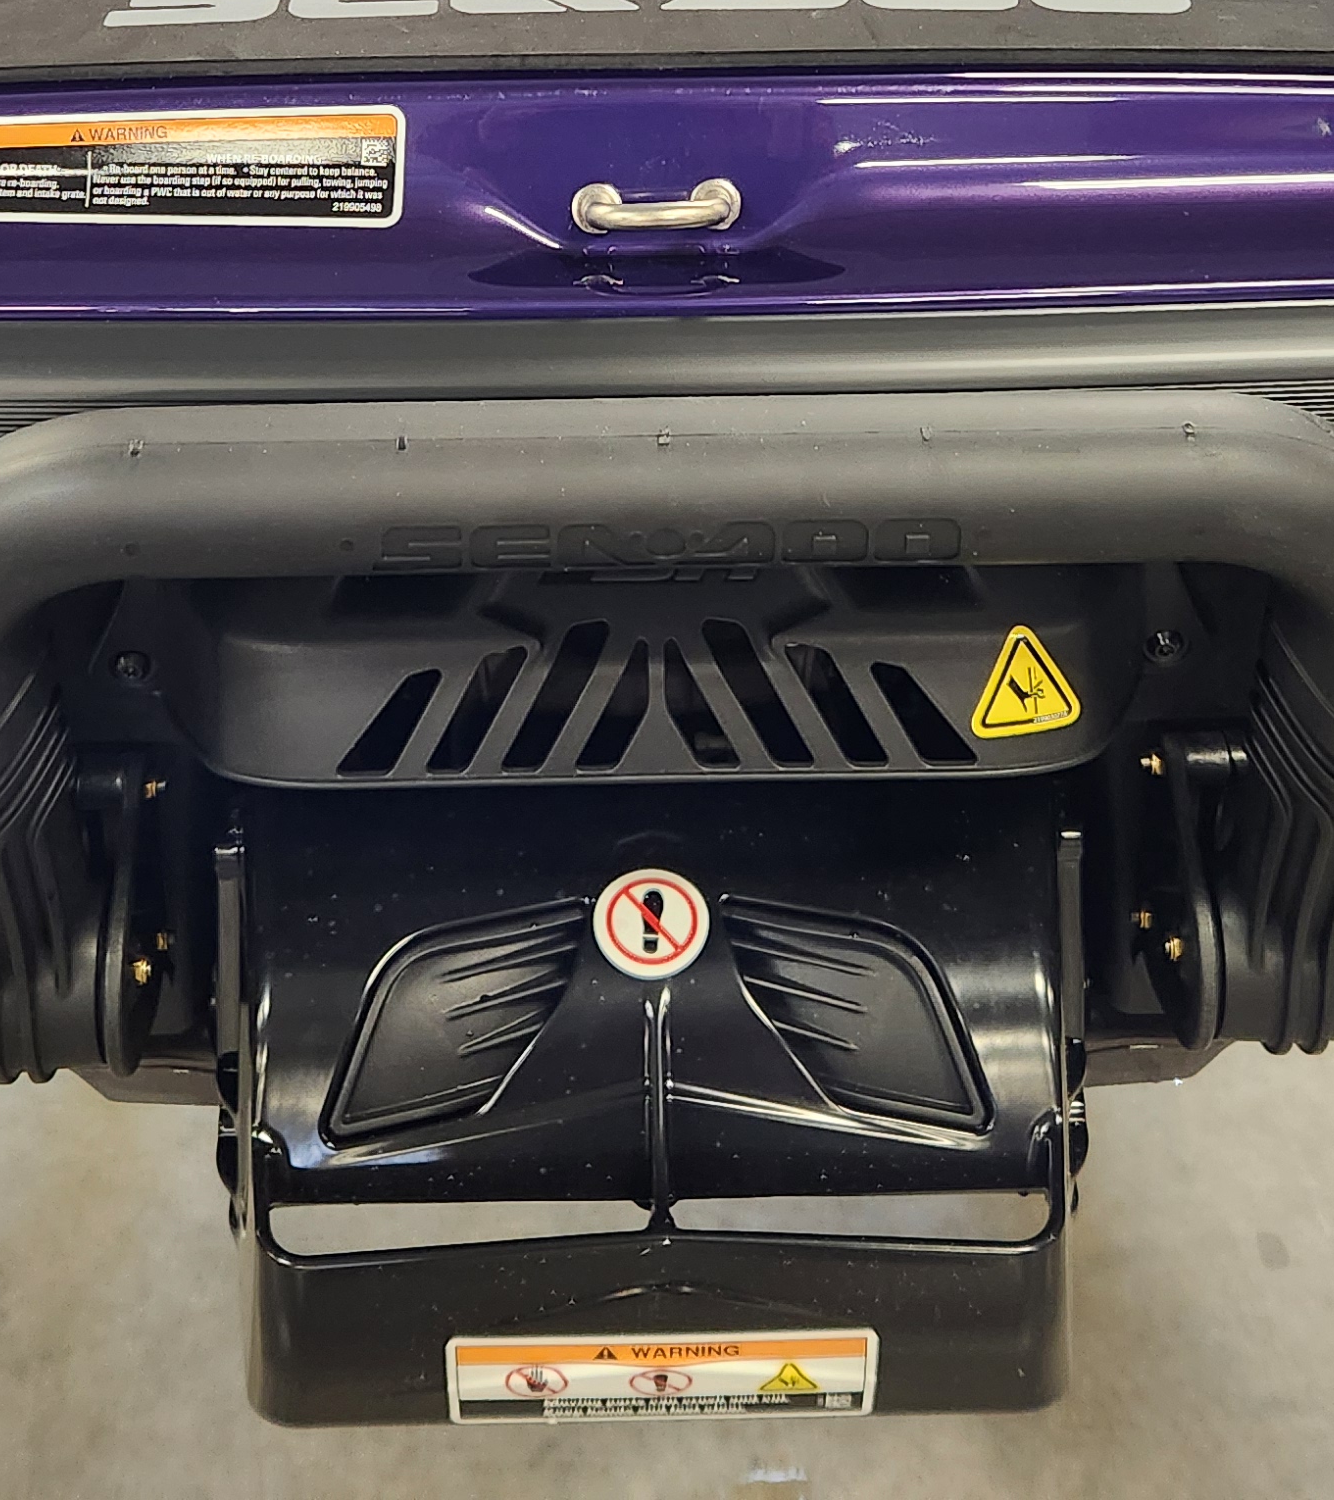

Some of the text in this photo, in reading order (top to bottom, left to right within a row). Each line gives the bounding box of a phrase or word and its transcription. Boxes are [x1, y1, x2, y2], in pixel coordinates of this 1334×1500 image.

[89, 125, 168, 141] WARNING
[109, 164, 149, 174] Re-board
[150, 166, 165, 174] one
[167, 166, 197, 176] person
[198, 166, 207, 174] at
[215, 166, 237, 175] time.
[249, 166, 269, 177] Stay
[270, 166, 307, 176] centered
[309, 167, 319, 176] to
[319, 167, 340, 178] keep
[341, 166, 377, 176] balance.
[7, 179, 59, 189] re-boarding.
[92, 175, 119, 184] Never
[121, 176, 137, 184] use
[137, 175, 151, 184] the
[153, 175, 191, 186] boarding
[191, 176, 211, 186] step
[222, 176, 233, 186] so
[234, 177, 276, 188] equipped)
[277, 178, 290, 186] for
[291, 178, 321, 188] pulling,
[323, 178, 353, 188] towing,
[355, 178, 389, 190] jumping
[17, 189, 33, 198] and
[34, 189, 60, 198] intake
[104, 186, 142, 197] boarding
[143, 188, 149, 196] a
[151, 187, 173, 196] PWC
[173, 187, 191, 196] that
[192, 188, 200, 196] is
[201, 188, 215, 197] out
[216, 188, 225, 197] of
[227, 189, 252, 198] water
[253, 190, 263, 198] or
[263, 190, 279, 200] any
[281, 190, 315, 200] purpose
[317, 190, 329, 198] for
[331, 190, 356, 199] which
[357, 190, 364, 199] it
[365, 192, 383, 200] was
[92, 196, 150, 206] not designed.
[630, 1344, 740, 1360] WARNING
